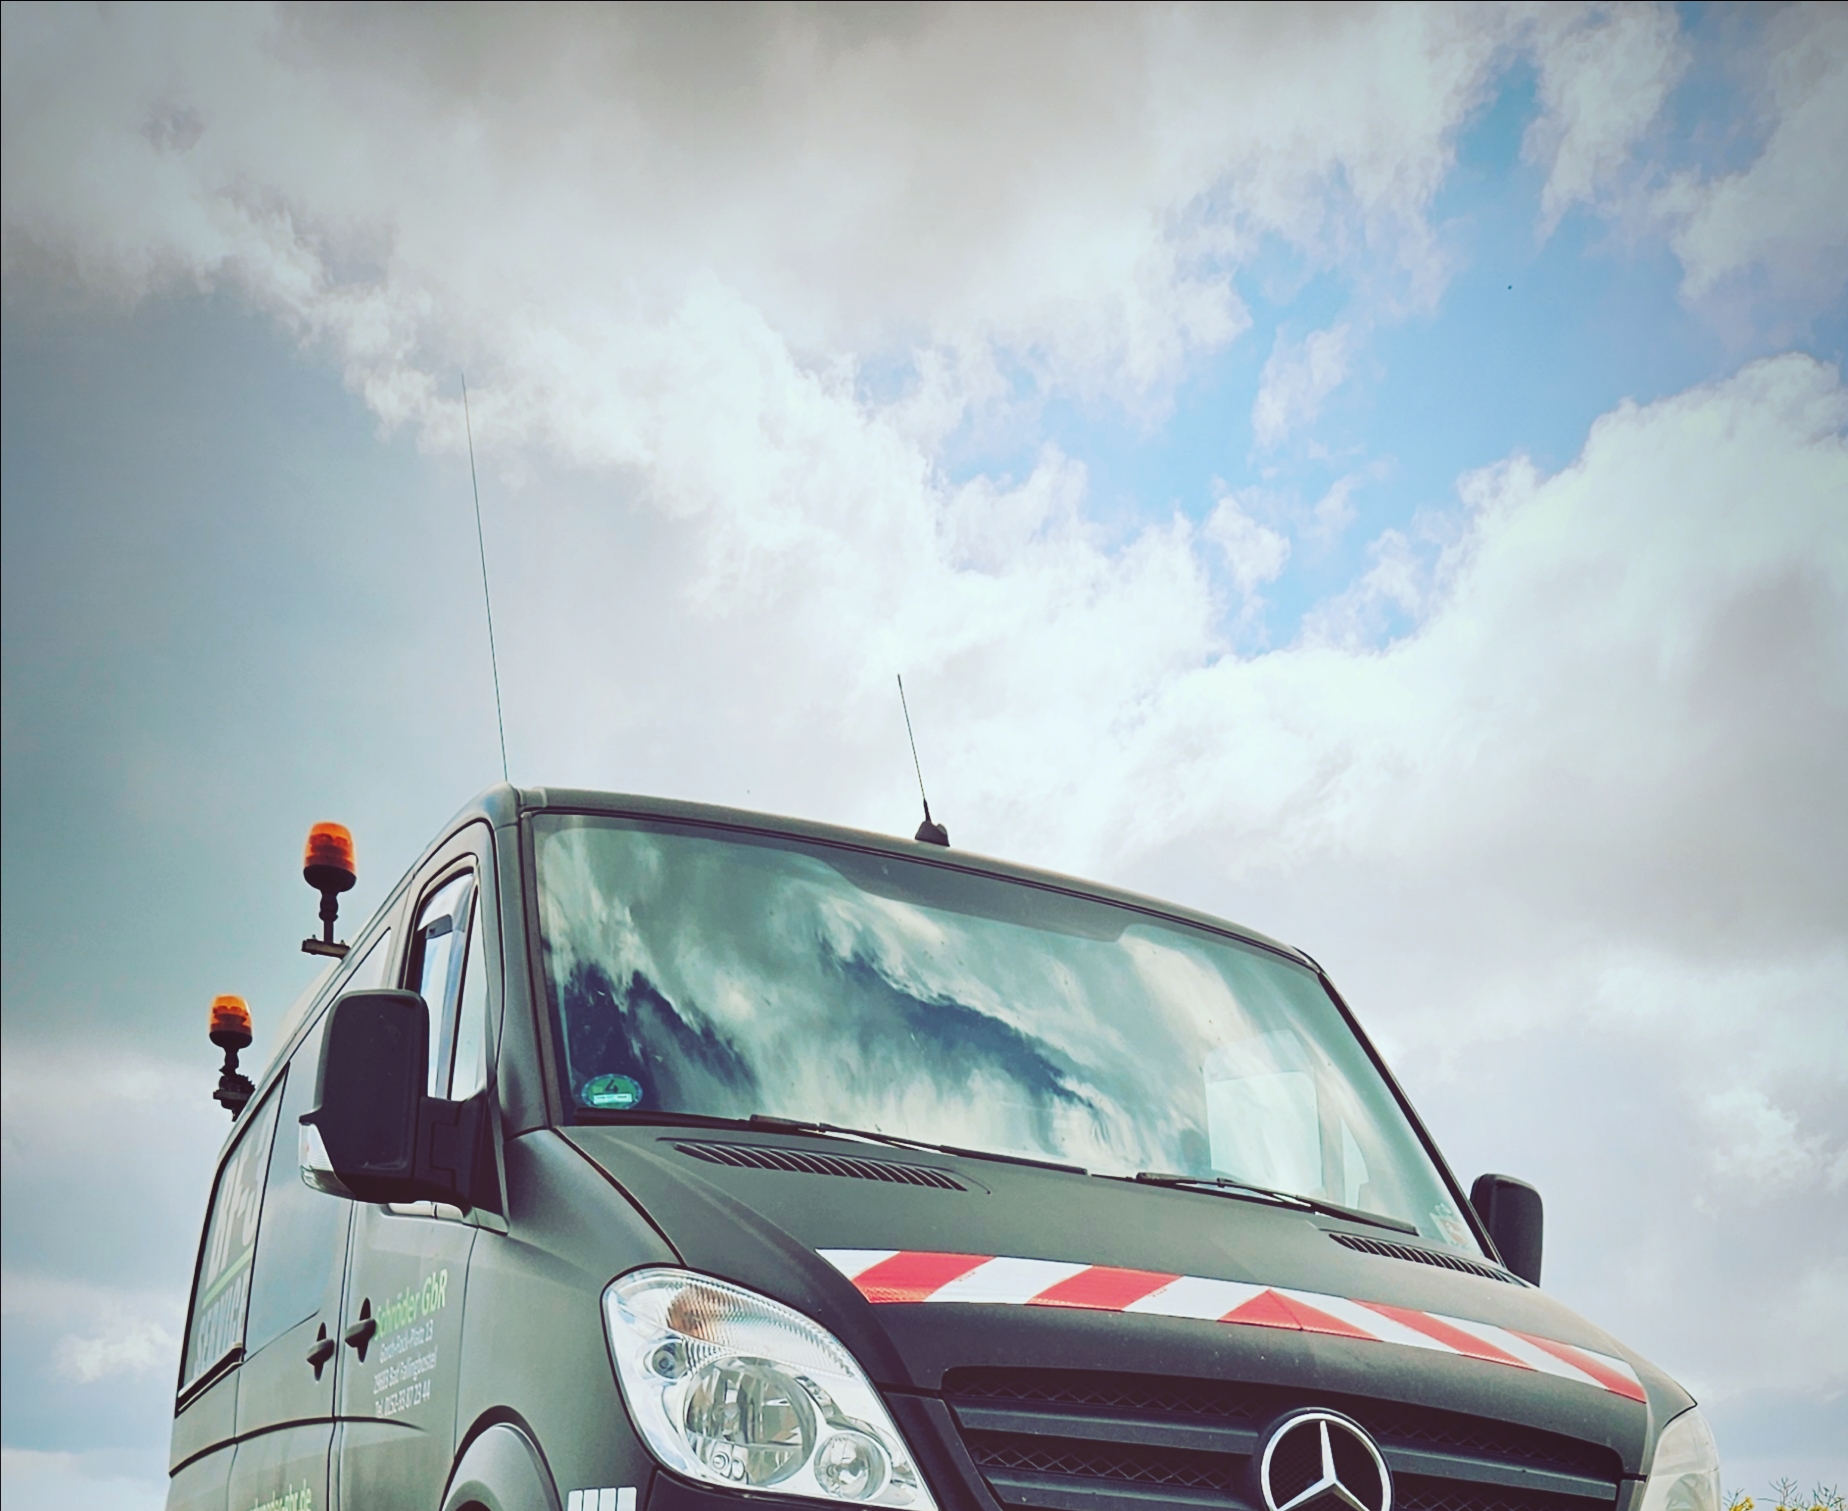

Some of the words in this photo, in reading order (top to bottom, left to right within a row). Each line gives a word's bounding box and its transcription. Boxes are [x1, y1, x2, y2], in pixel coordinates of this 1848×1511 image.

[605, 1079, 618, 1093] 4
[374, 1286, 420, 1341] Schröder
[421, 1269, 448, 1316] GbR
